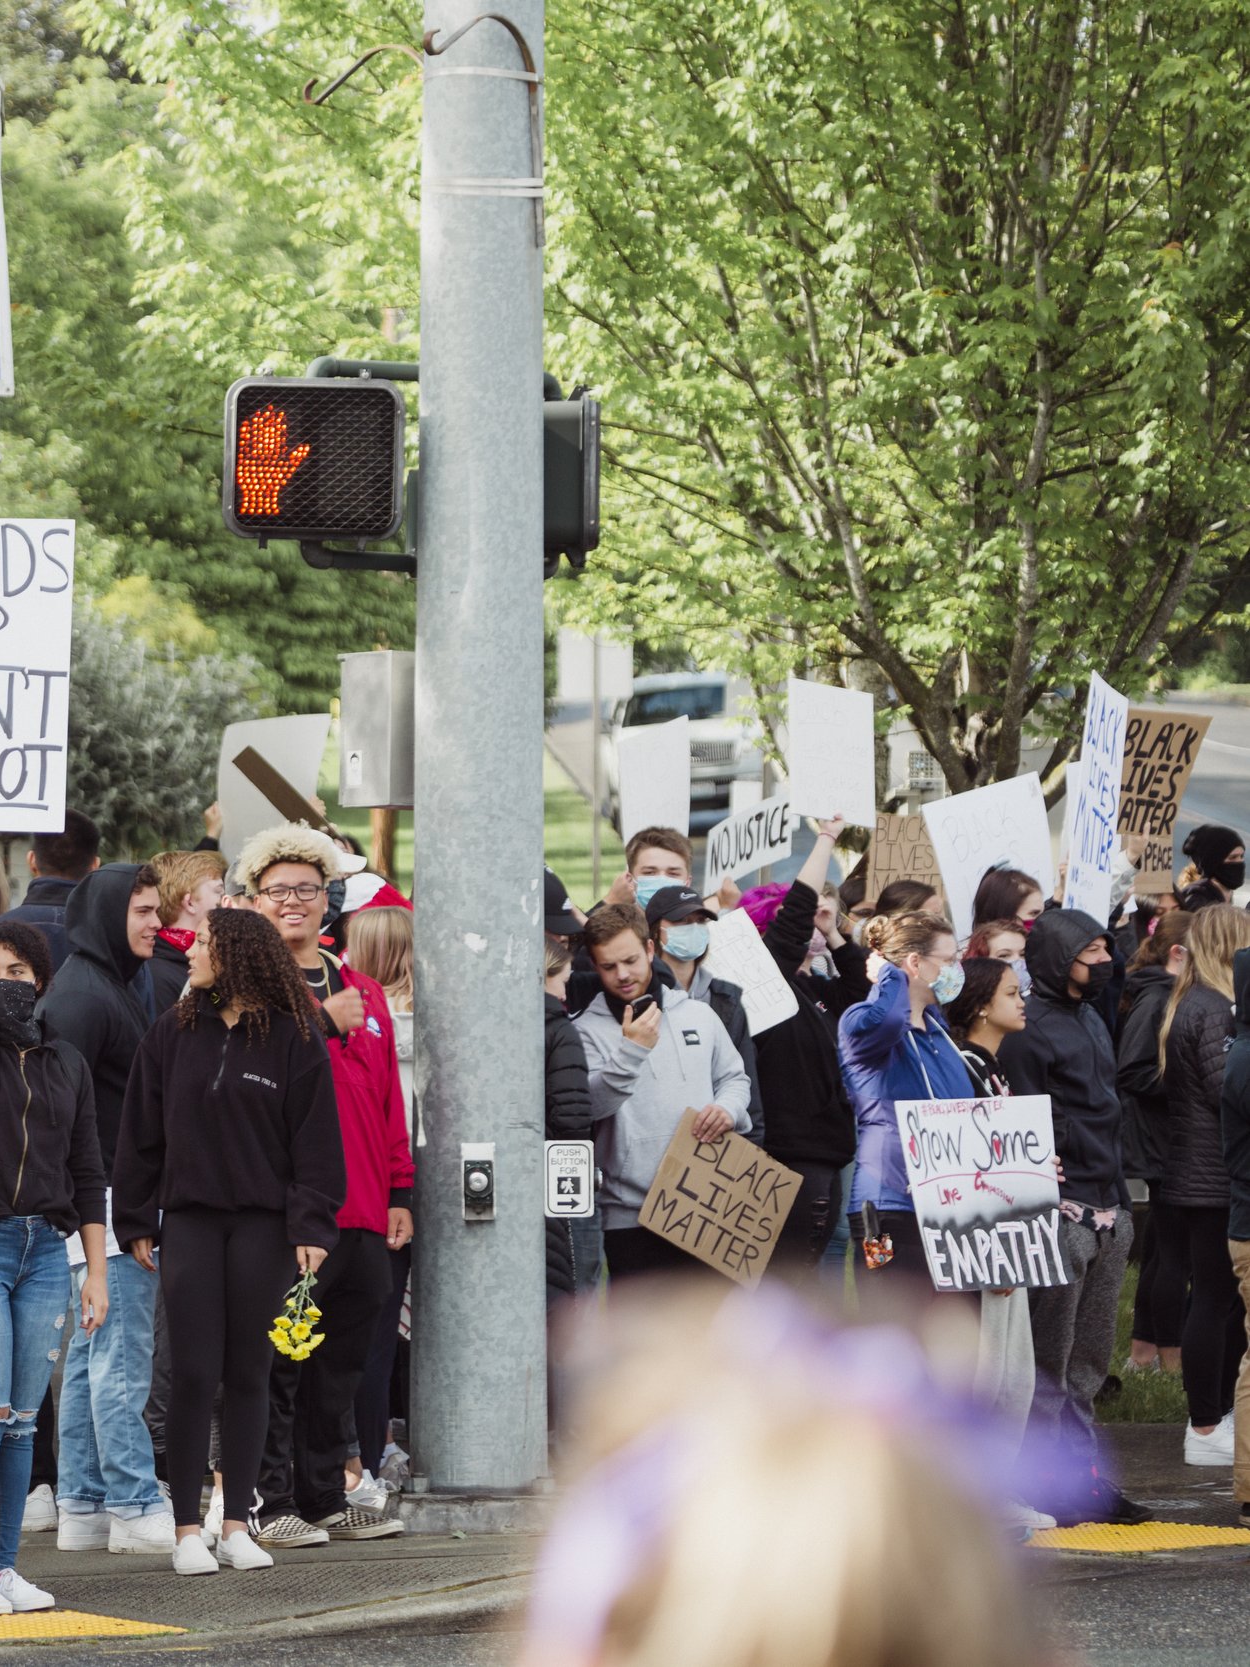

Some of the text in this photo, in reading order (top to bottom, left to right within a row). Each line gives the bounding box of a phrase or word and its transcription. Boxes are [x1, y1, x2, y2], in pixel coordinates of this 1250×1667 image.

[1087, 684, 1123, 768] BLACK
[1123, 718, 1199, 765] BLACK
[1089, 753, 1116, 819] LIVES
[1120, 759, 1184, 802] IVES
[875, 815, 930, 843] BLACK
[1073, 792, 1114, 874] MATTER
[1116, 797, 1178, 835] ATTER
[874, 842, 935, 871] LIVES
[1144, 842, 1173, 873] PEACE
[550, 1157, 587, 1166] BUTTON
[556, 1148, 581, 1157] PUSH
[906, 1100, 1052, 1179] Show Some
[559, 1166, 578, 1175] FOR
[693, 1133, 792, 1214] BLACK
[675, 1166, 773, 1243] LIVES
[648, 1188, 760, 1279] MATTER
[923, 1208, 1069, 1290] EMPATHY
